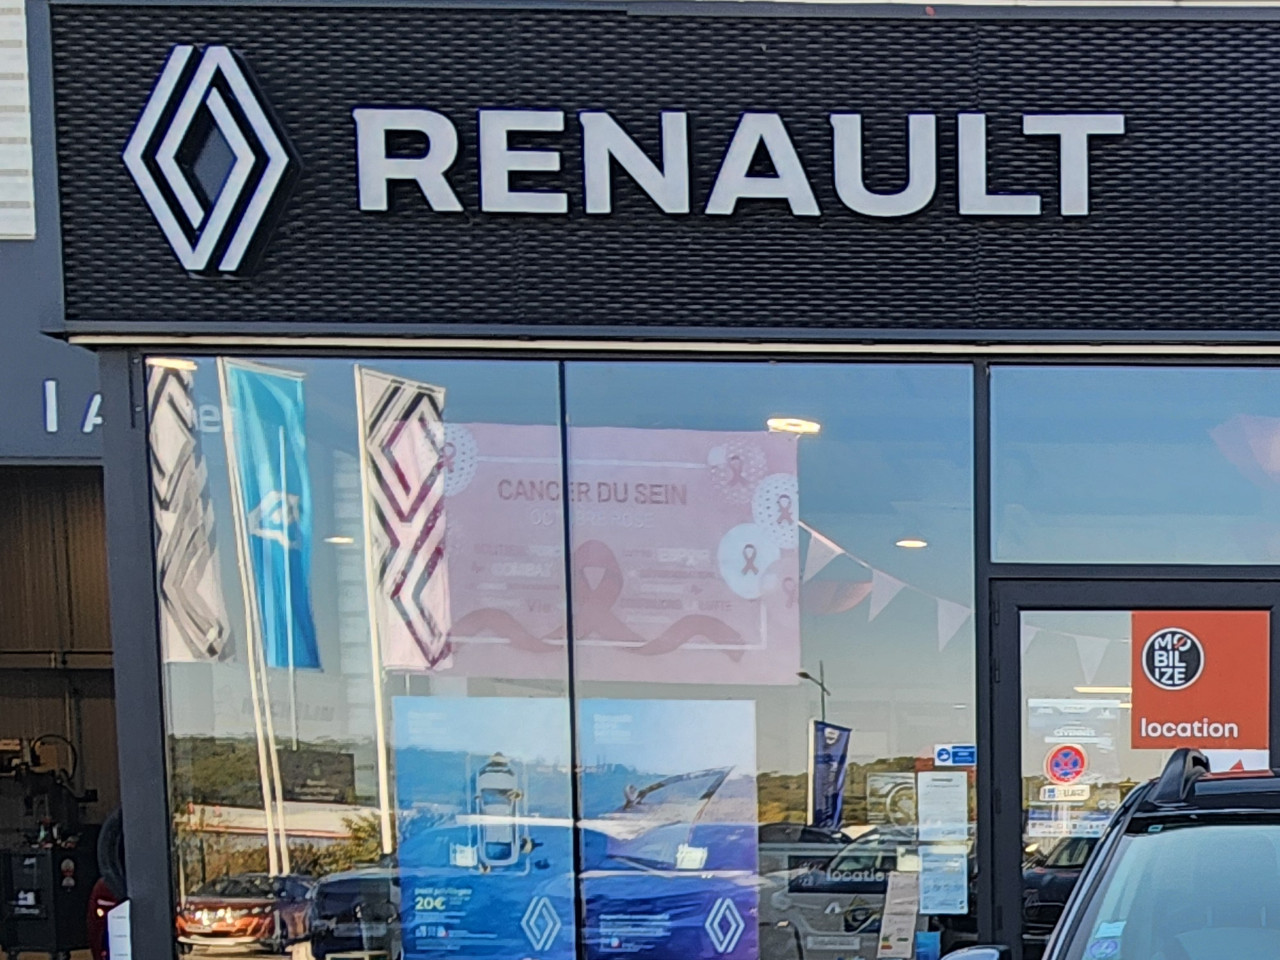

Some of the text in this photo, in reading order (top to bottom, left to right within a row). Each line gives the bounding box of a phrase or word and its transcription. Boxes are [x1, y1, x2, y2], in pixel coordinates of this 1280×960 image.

[353, 107, 1125, 217] RENAULT
[597, 482, 628, 503] DU
[634, 484, 687, 505] SEIN
[1140, 718, 1238, 738] location
[825, 868, 890, 882] locatio
[415, 895, 446, 911] 20€
